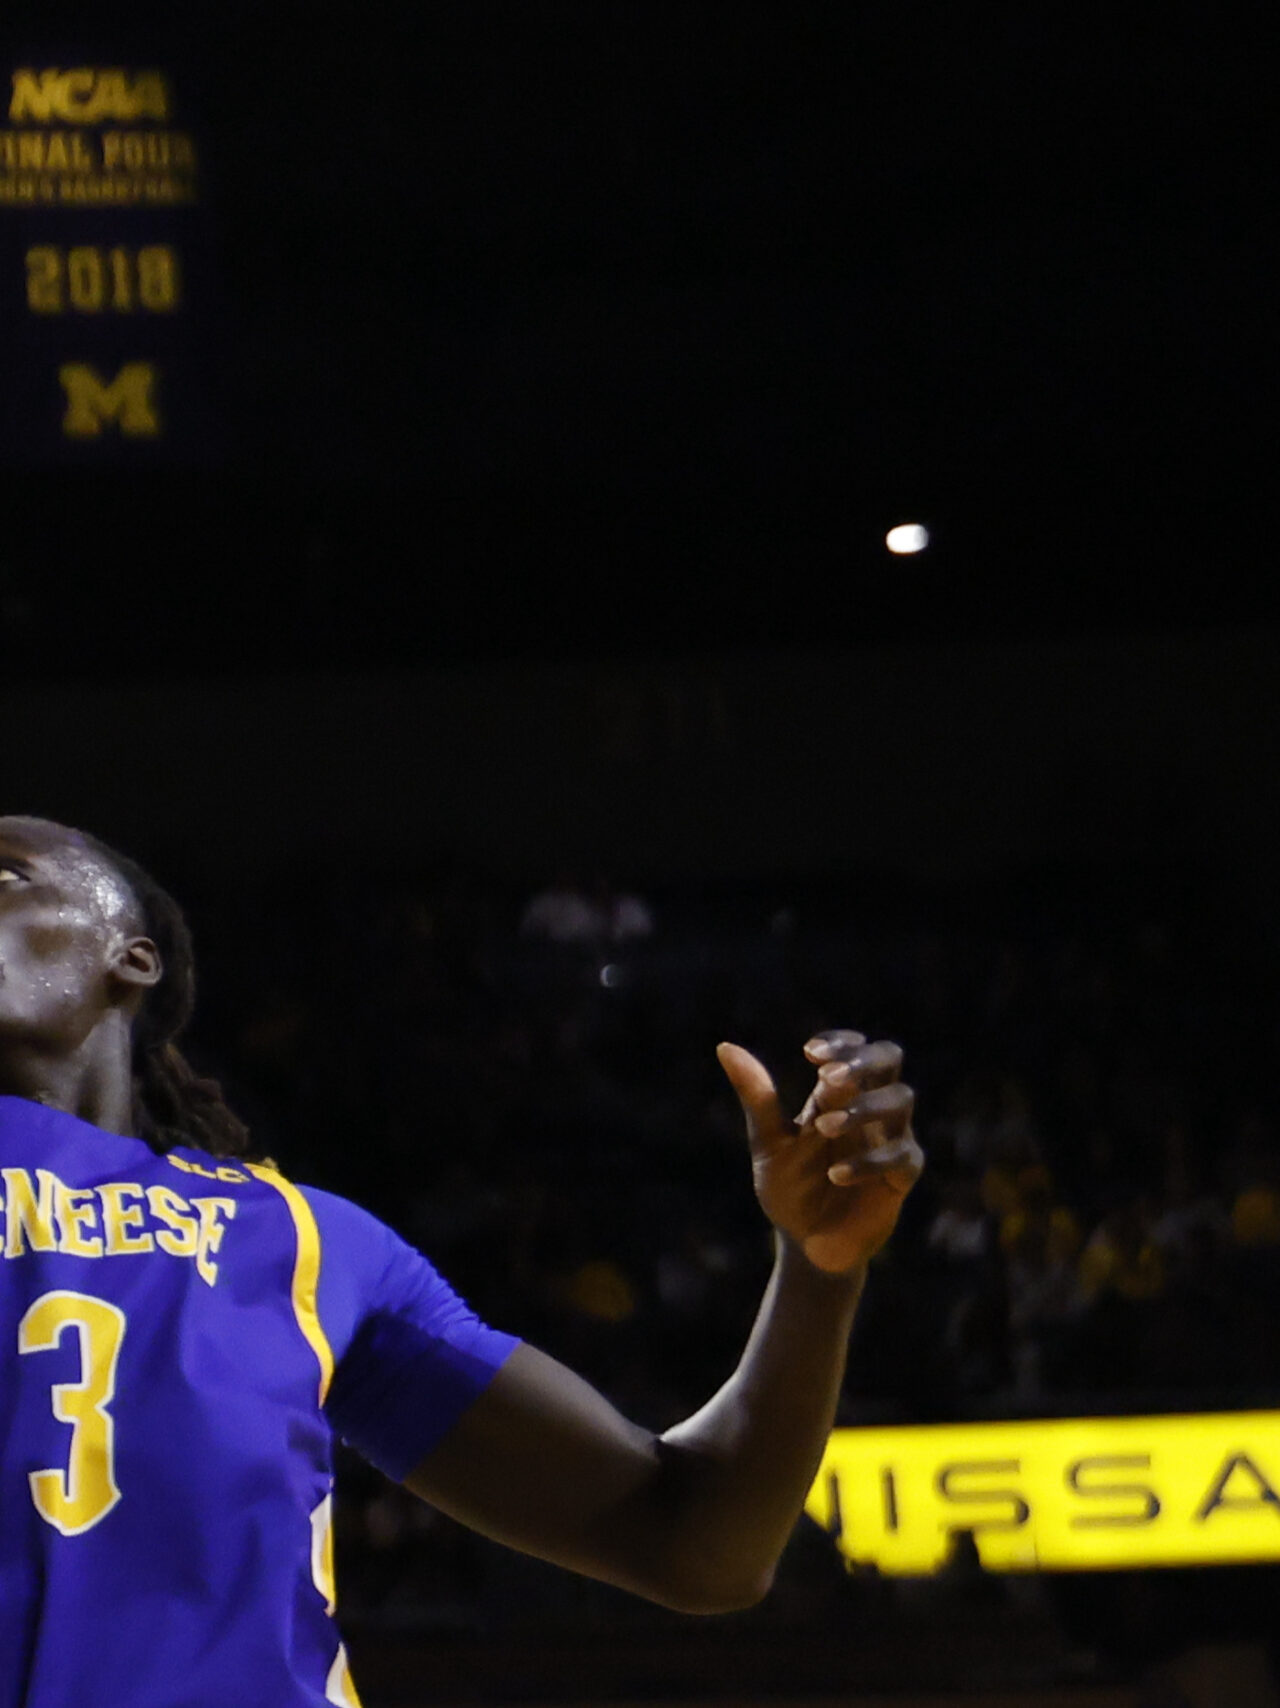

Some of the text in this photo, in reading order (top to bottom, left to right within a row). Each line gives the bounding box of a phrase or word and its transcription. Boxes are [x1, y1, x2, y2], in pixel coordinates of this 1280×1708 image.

[8, 68, 171, 122] NCAA
[26, 245, 180, 312] 2018
[58, 361, 160, 437] M
[18, 1289, 126, 1537] 3
